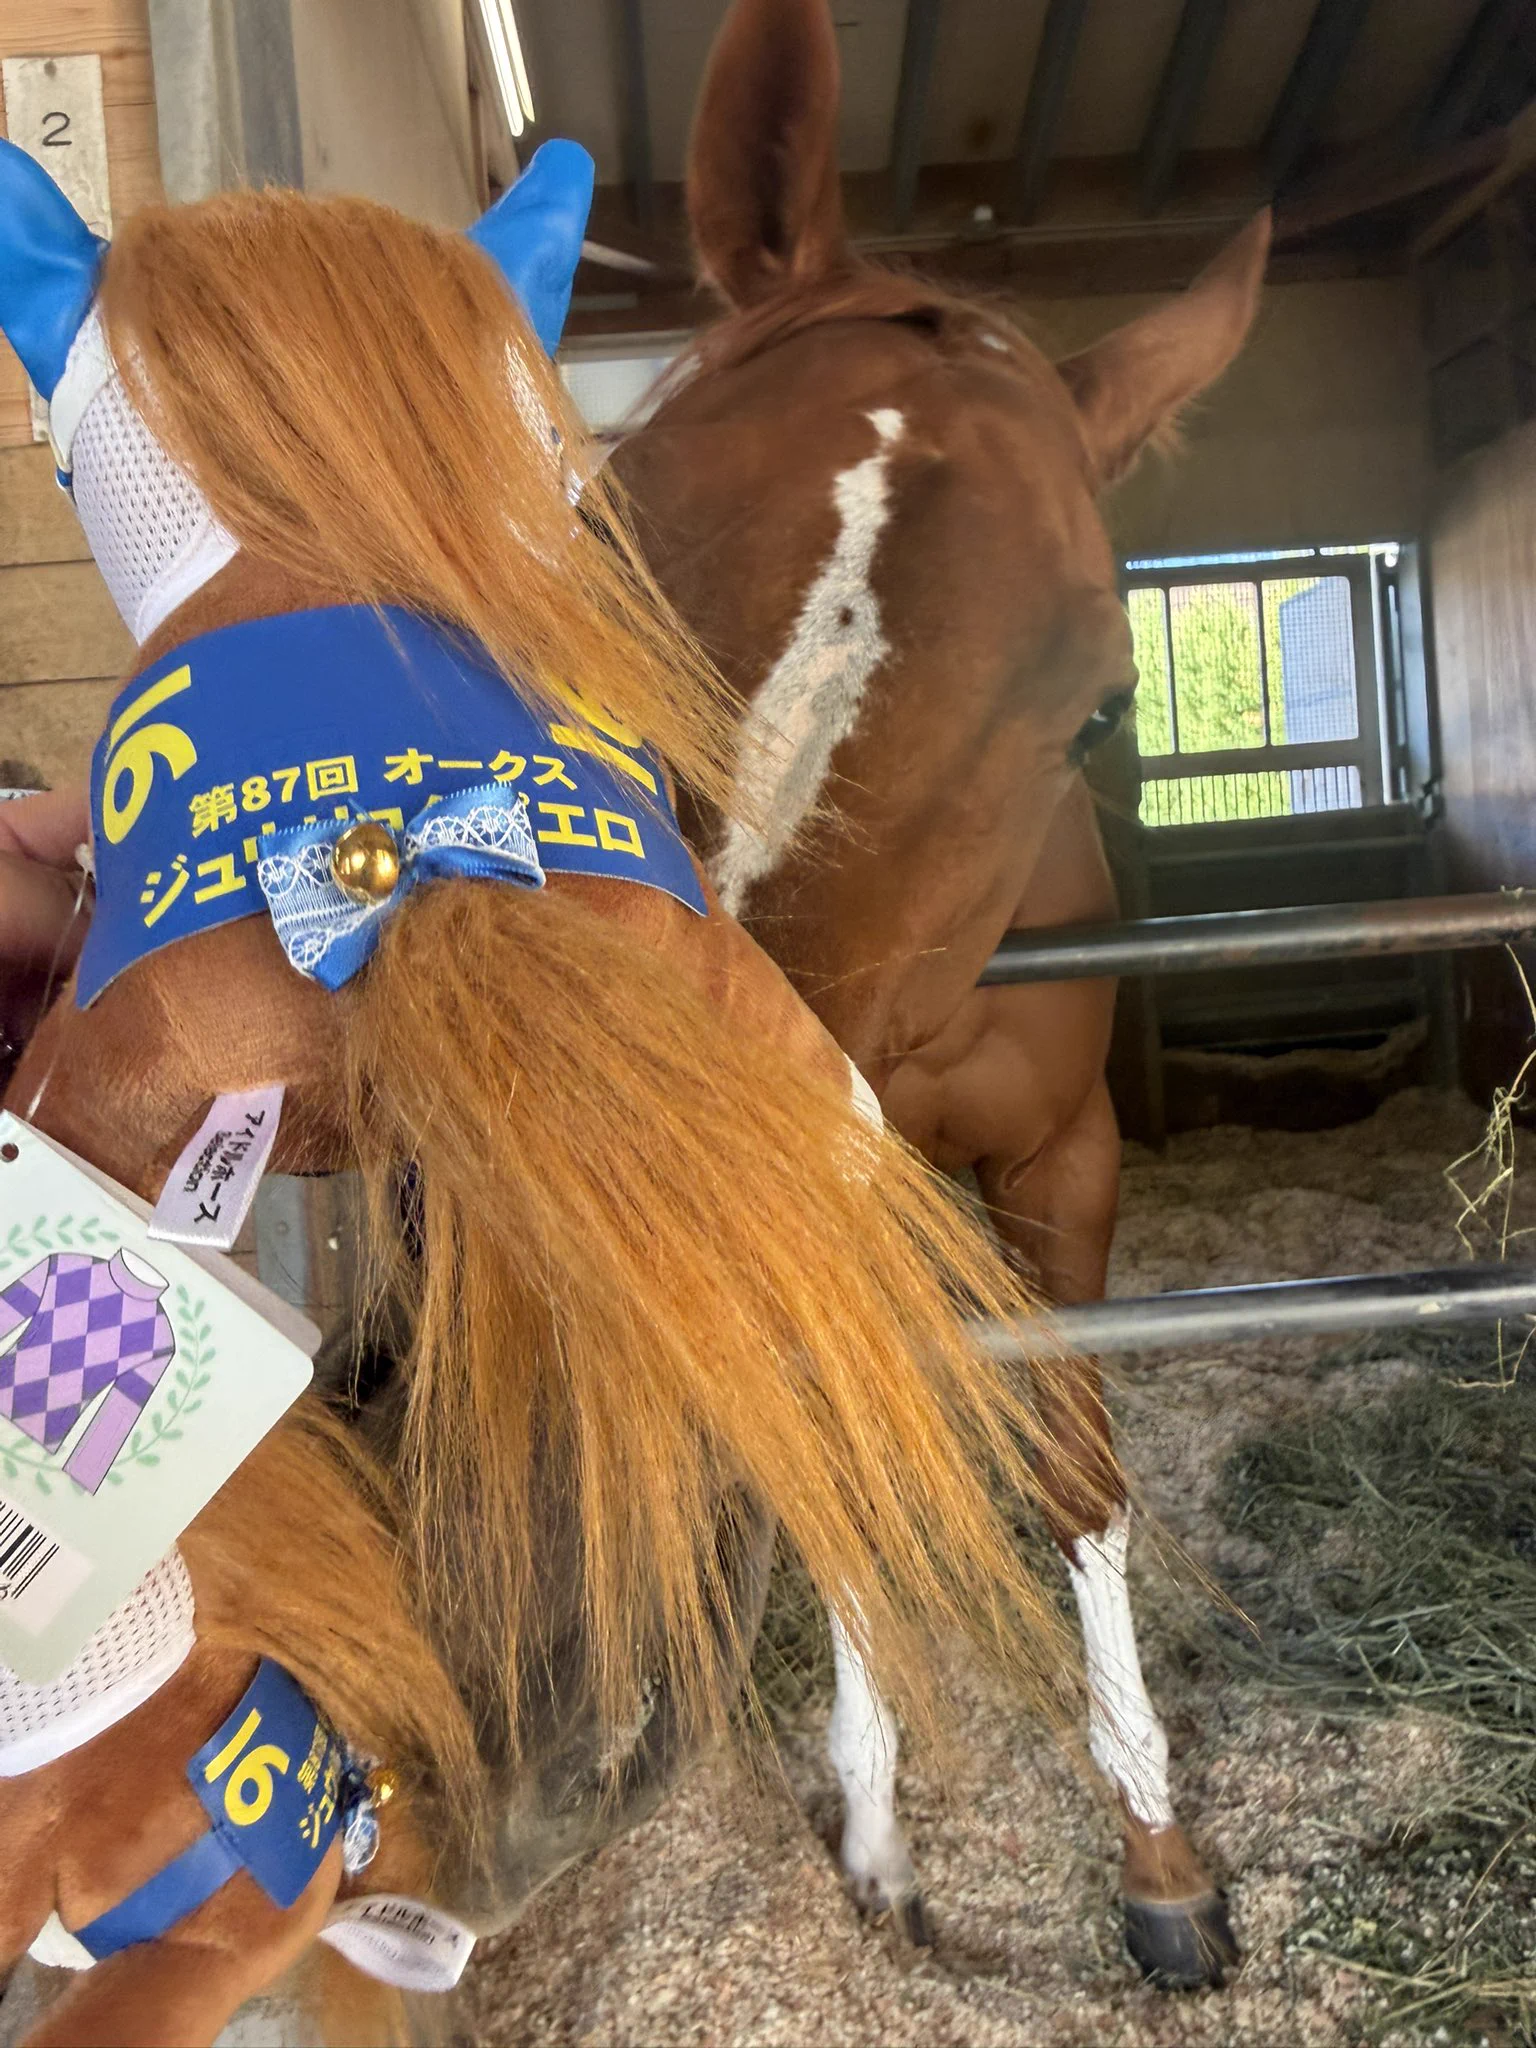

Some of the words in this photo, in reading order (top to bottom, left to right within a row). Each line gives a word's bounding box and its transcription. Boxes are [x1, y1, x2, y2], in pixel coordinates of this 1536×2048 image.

[42, 111, 72, 146] 2
[103, 664, 198, 845] 16
[188, 754, 358, 839] 第87回
[384, 747, 577, 790] オークス
[204, 1707, 291, 1826] 16
